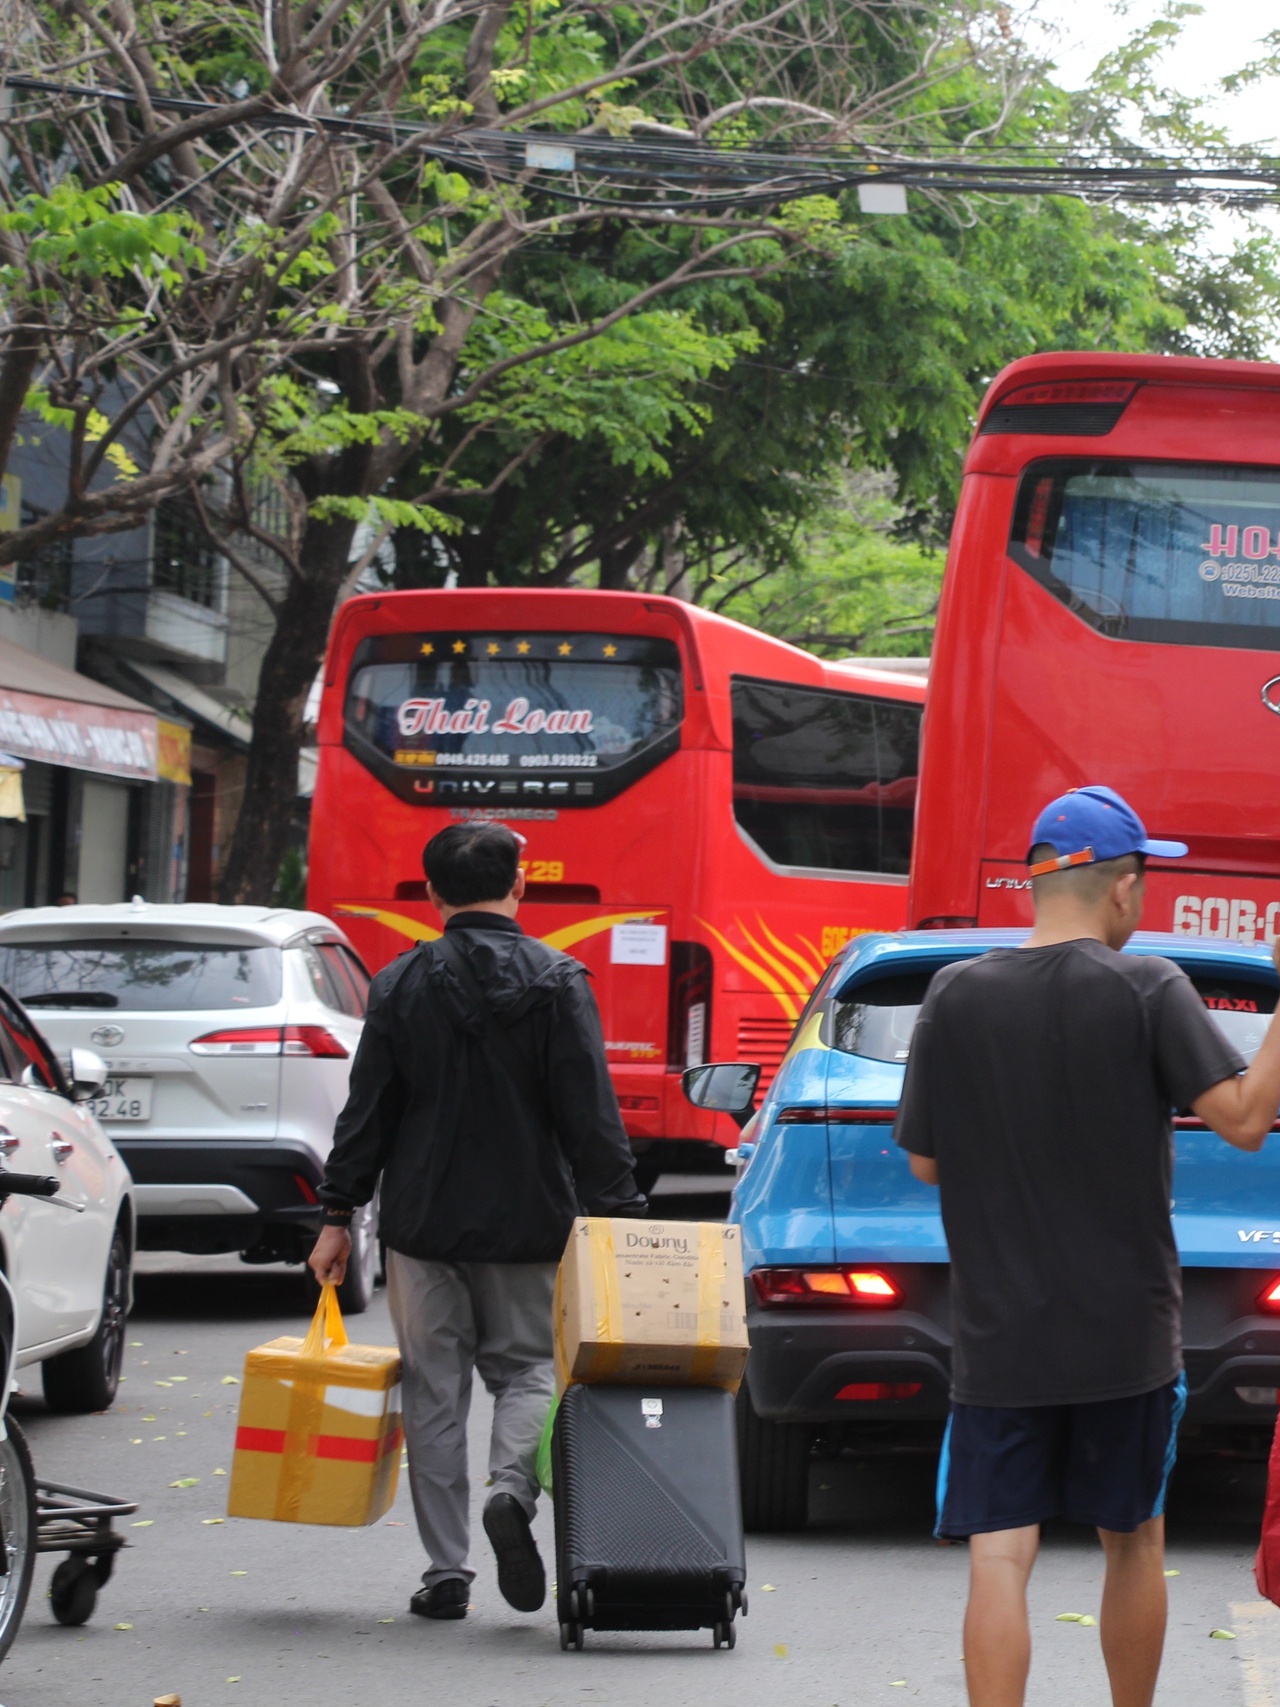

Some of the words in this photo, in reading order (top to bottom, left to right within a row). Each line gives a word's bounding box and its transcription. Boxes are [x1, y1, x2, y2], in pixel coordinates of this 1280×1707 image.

[397, 697, 492, 736] Thái
[491, 696, 594, 735] Loan
[413, 780, 595, 796] UNIVERSE
[985, 877, 1033, 890] UNIVE
[1203, 996, 1259, 1013] TAXI
[104, 1079, 127, 1097] 0K
[86, 1100, 141, 1118] 92.48
[626, 1232, 688, 1254] Downy
